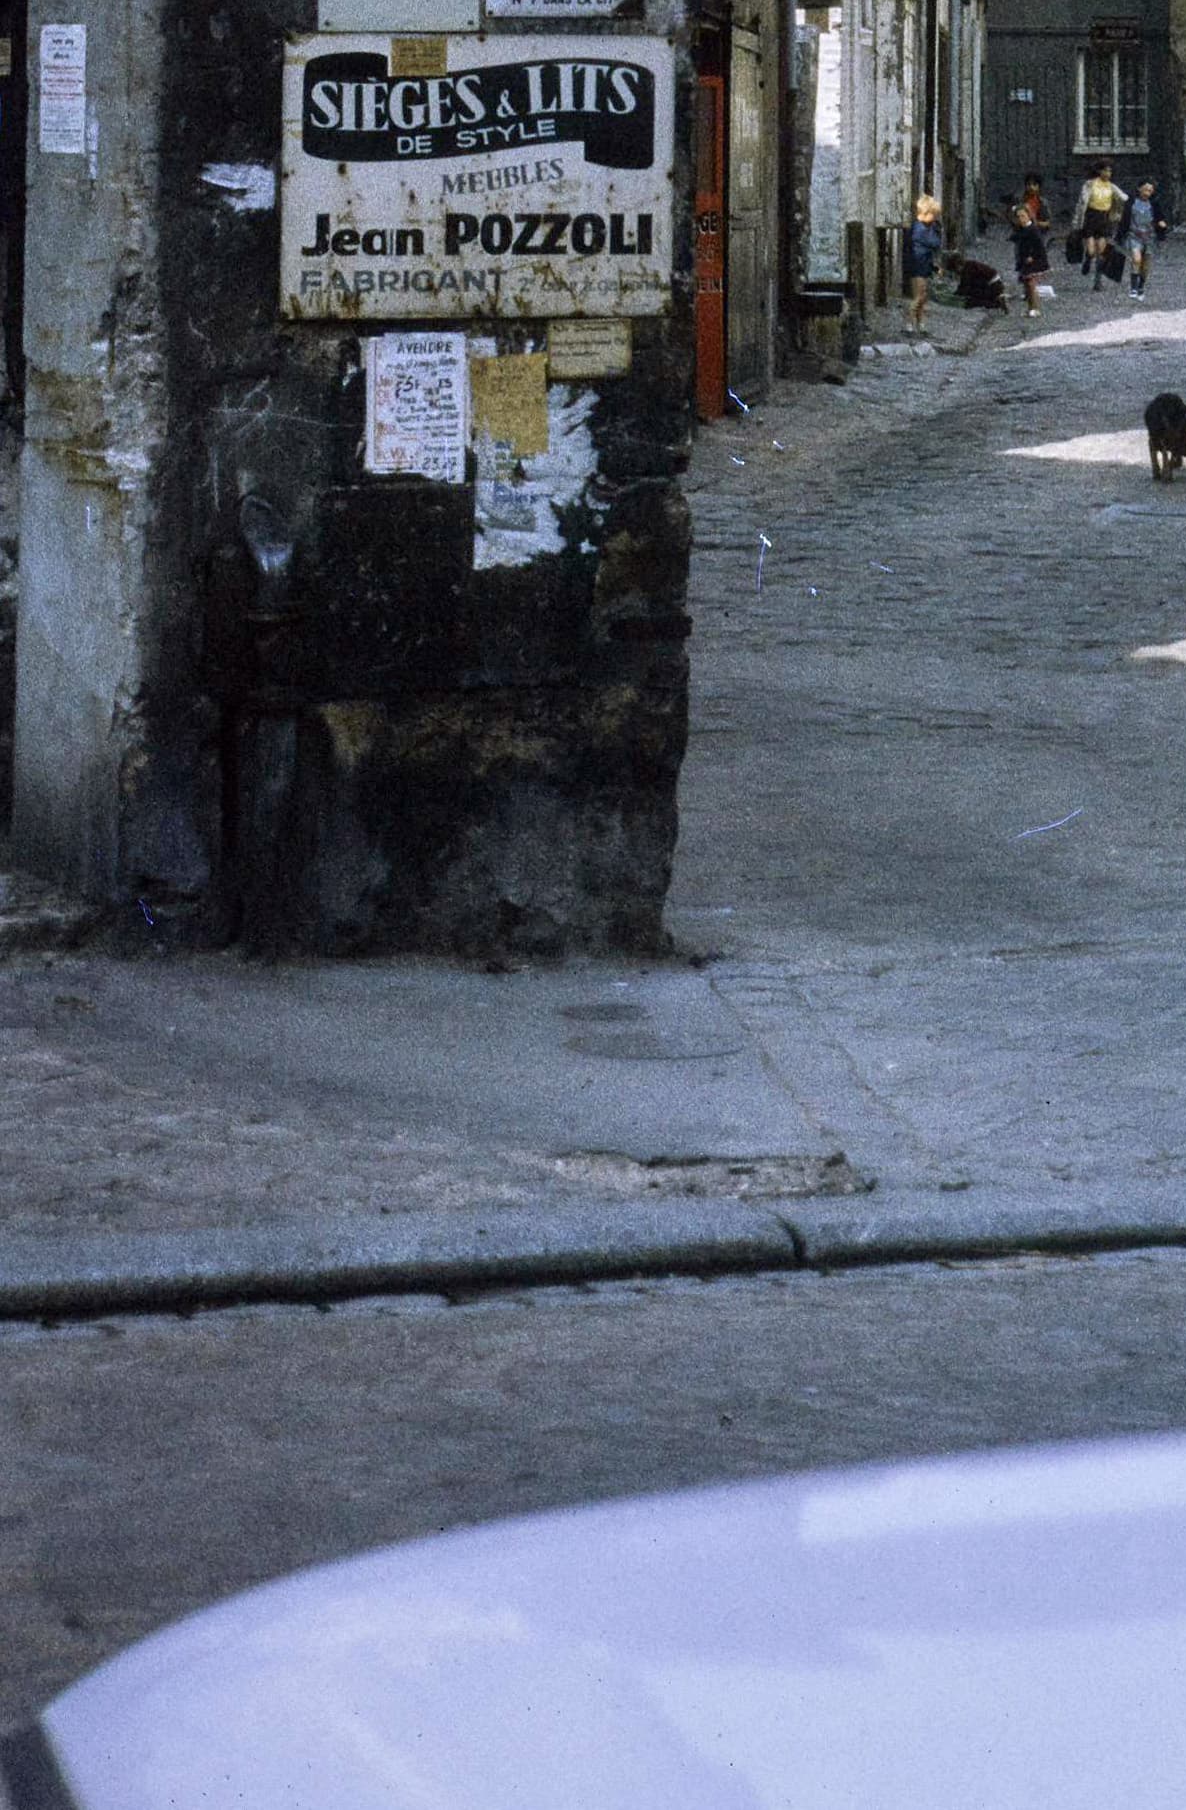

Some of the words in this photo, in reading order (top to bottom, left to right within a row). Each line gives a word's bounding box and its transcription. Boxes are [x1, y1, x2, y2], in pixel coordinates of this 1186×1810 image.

[310, 75, 486, 131] SIÈGES
[496, 90, 517, 118] &
[526, 63, 640, 114] LITS
[397, 135, 432, 154] DE
[456, 119, 556, 148] STYLE
[441, 158, 565, 195] MEUBLES
[301, 213, 424, 256] Jean
[445, 213, 653, 256] POZZOLI
